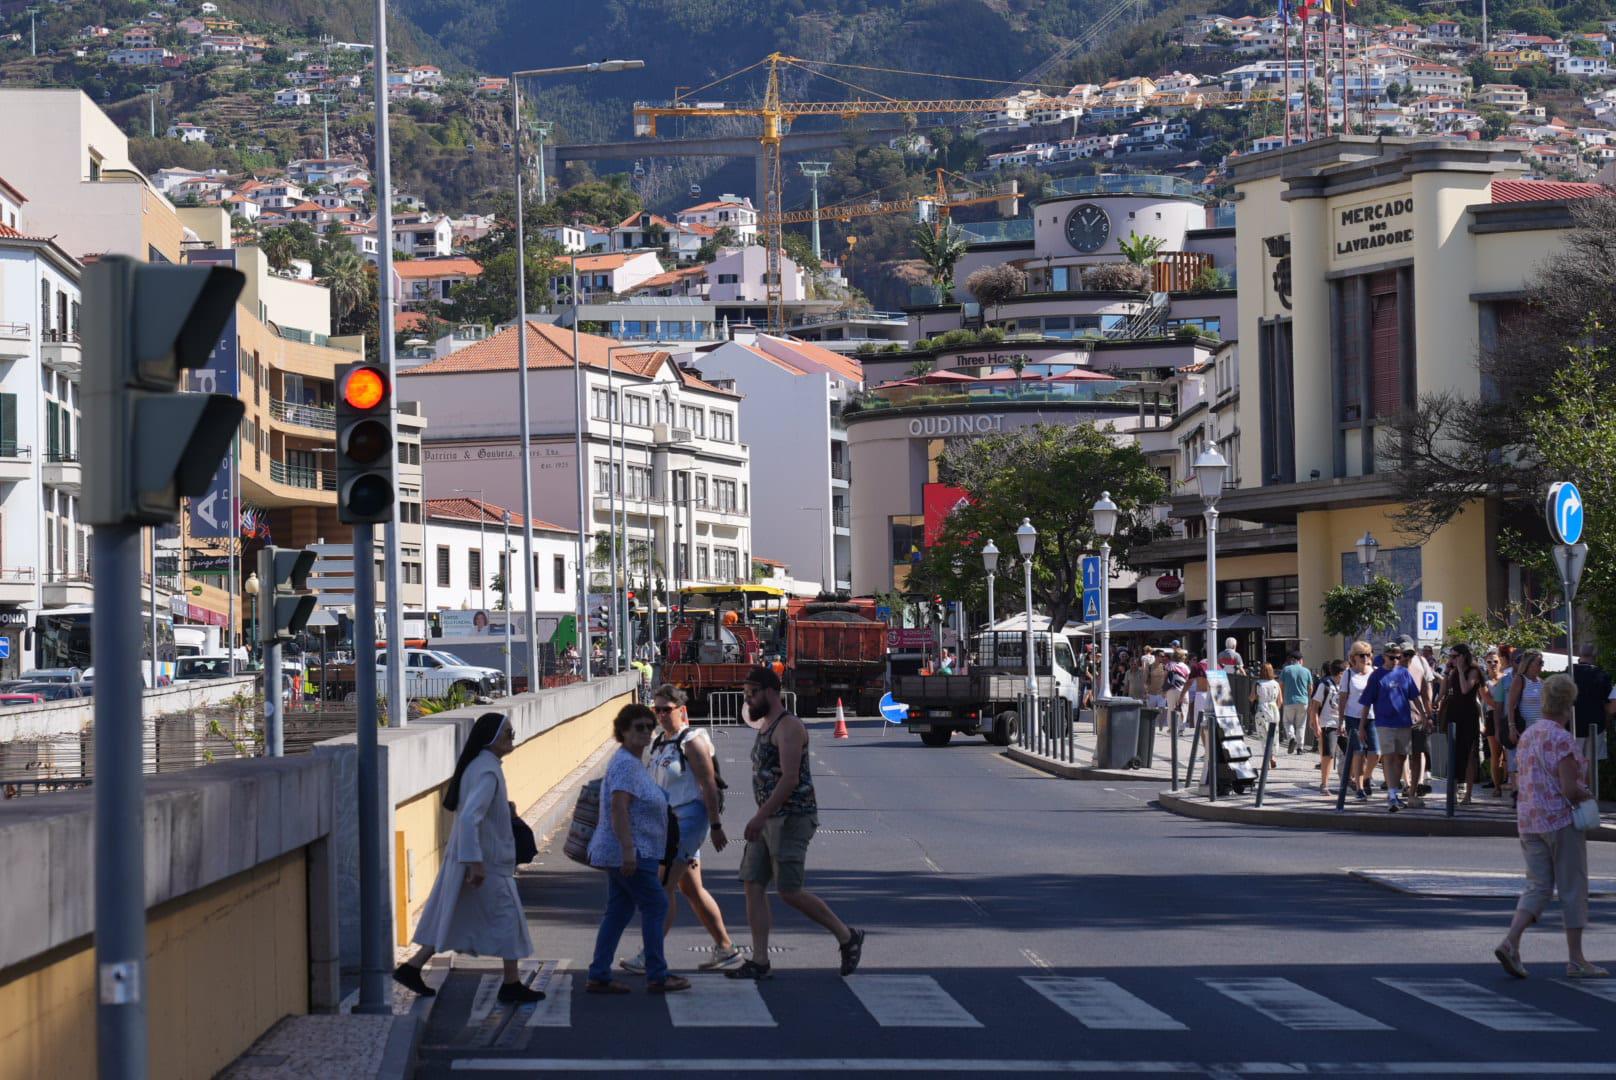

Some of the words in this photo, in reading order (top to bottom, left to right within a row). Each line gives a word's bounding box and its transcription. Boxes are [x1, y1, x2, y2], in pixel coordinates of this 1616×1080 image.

[1341, 198, 1413, 226] MERCADO
[1369, 221, 1387, 232] DOS
[1337, 229, 1414, 254] LAVRADORE
[956, 353, 985, 366] Three
[909, 414, 1005, 436] OUDINOT
[464, 449, 471, 460] &
[0, 613, 27, 624] ONIA
[1425, 612, 1435, 629] P
